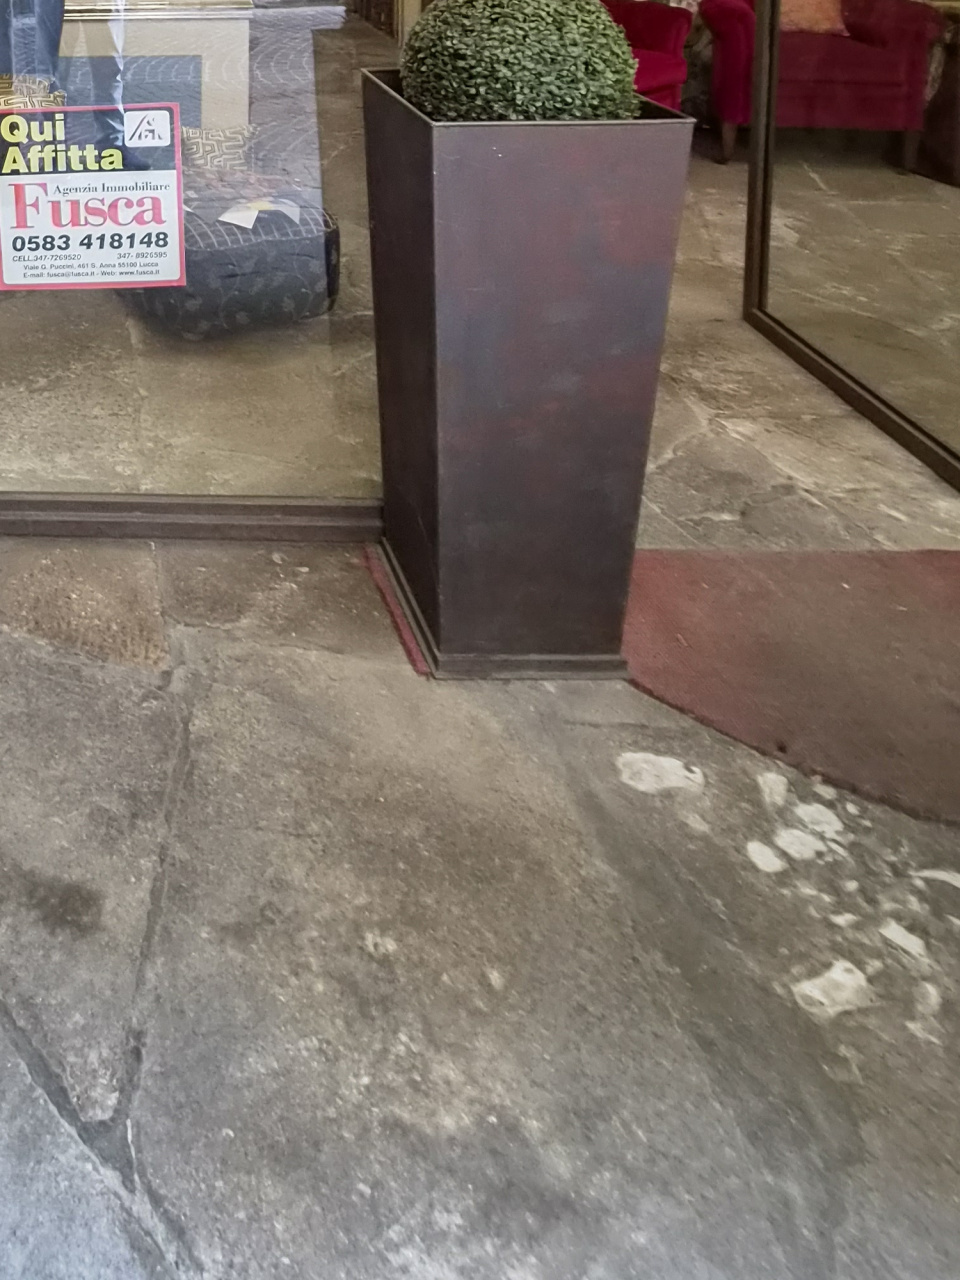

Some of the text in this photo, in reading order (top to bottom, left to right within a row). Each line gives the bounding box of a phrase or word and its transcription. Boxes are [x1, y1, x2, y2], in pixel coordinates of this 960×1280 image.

[0, 113, 65, 143] Qui
[1, 144, 123, 173] Affitta
[52, 181, 170, 197] Agenzia Immobiliare
[8, 182, 167, 229] Fusca
[12, 231, 169, 252] 0583 418148
